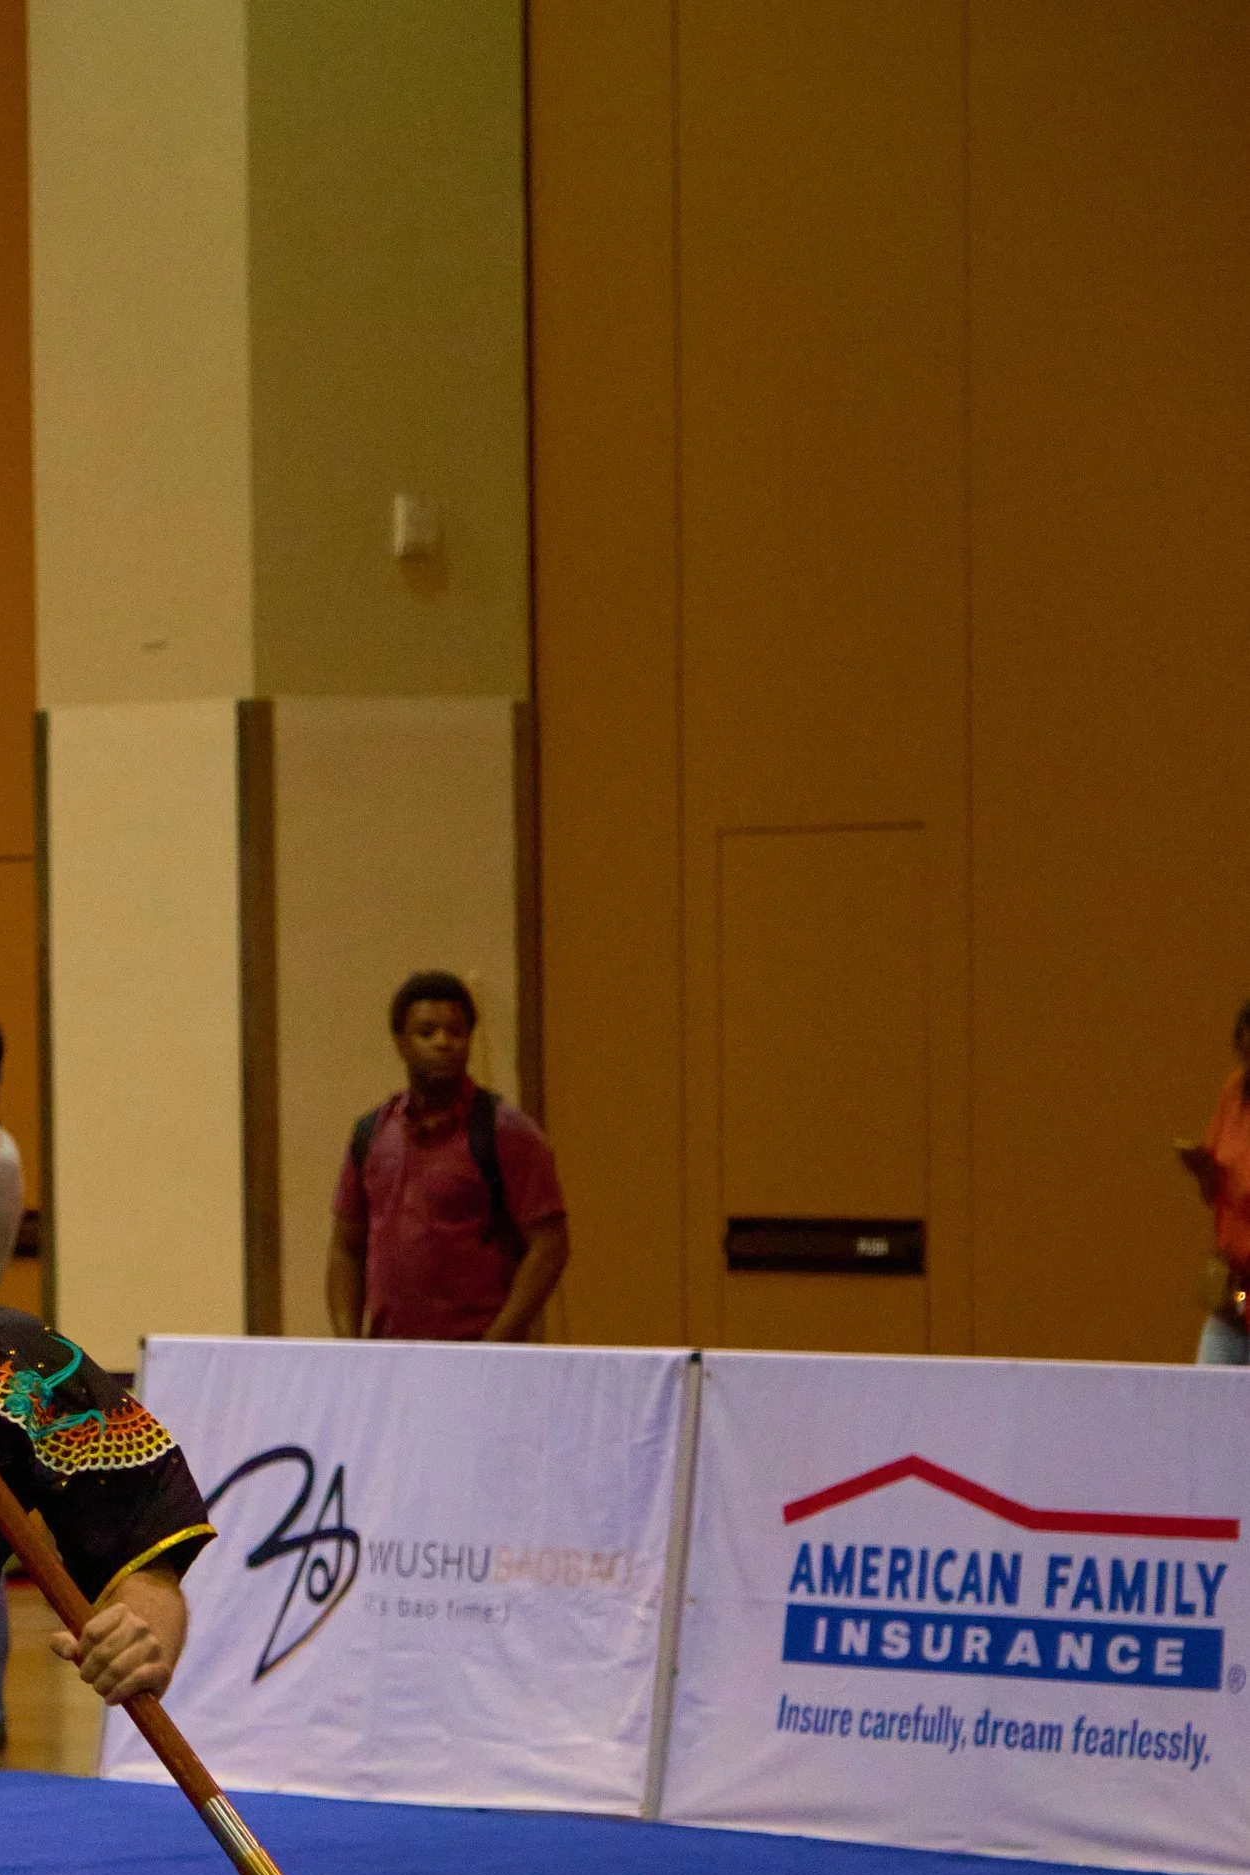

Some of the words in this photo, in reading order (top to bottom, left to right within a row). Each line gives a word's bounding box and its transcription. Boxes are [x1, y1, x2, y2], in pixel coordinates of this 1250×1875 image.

[789, 1542, 1022, 1606] AMERICAN
[1045, 1553, 1228, 1618] FAMILY
[814, 1617, 1184, 1676] INSURANCE
[777, 1695, 852, 1737] Insure
[859, 1704, 967, 1753] carefully,
[974, 1708, 1062, 1753] dream
[1072, 1716, 1211, 1772] fearlessly.
